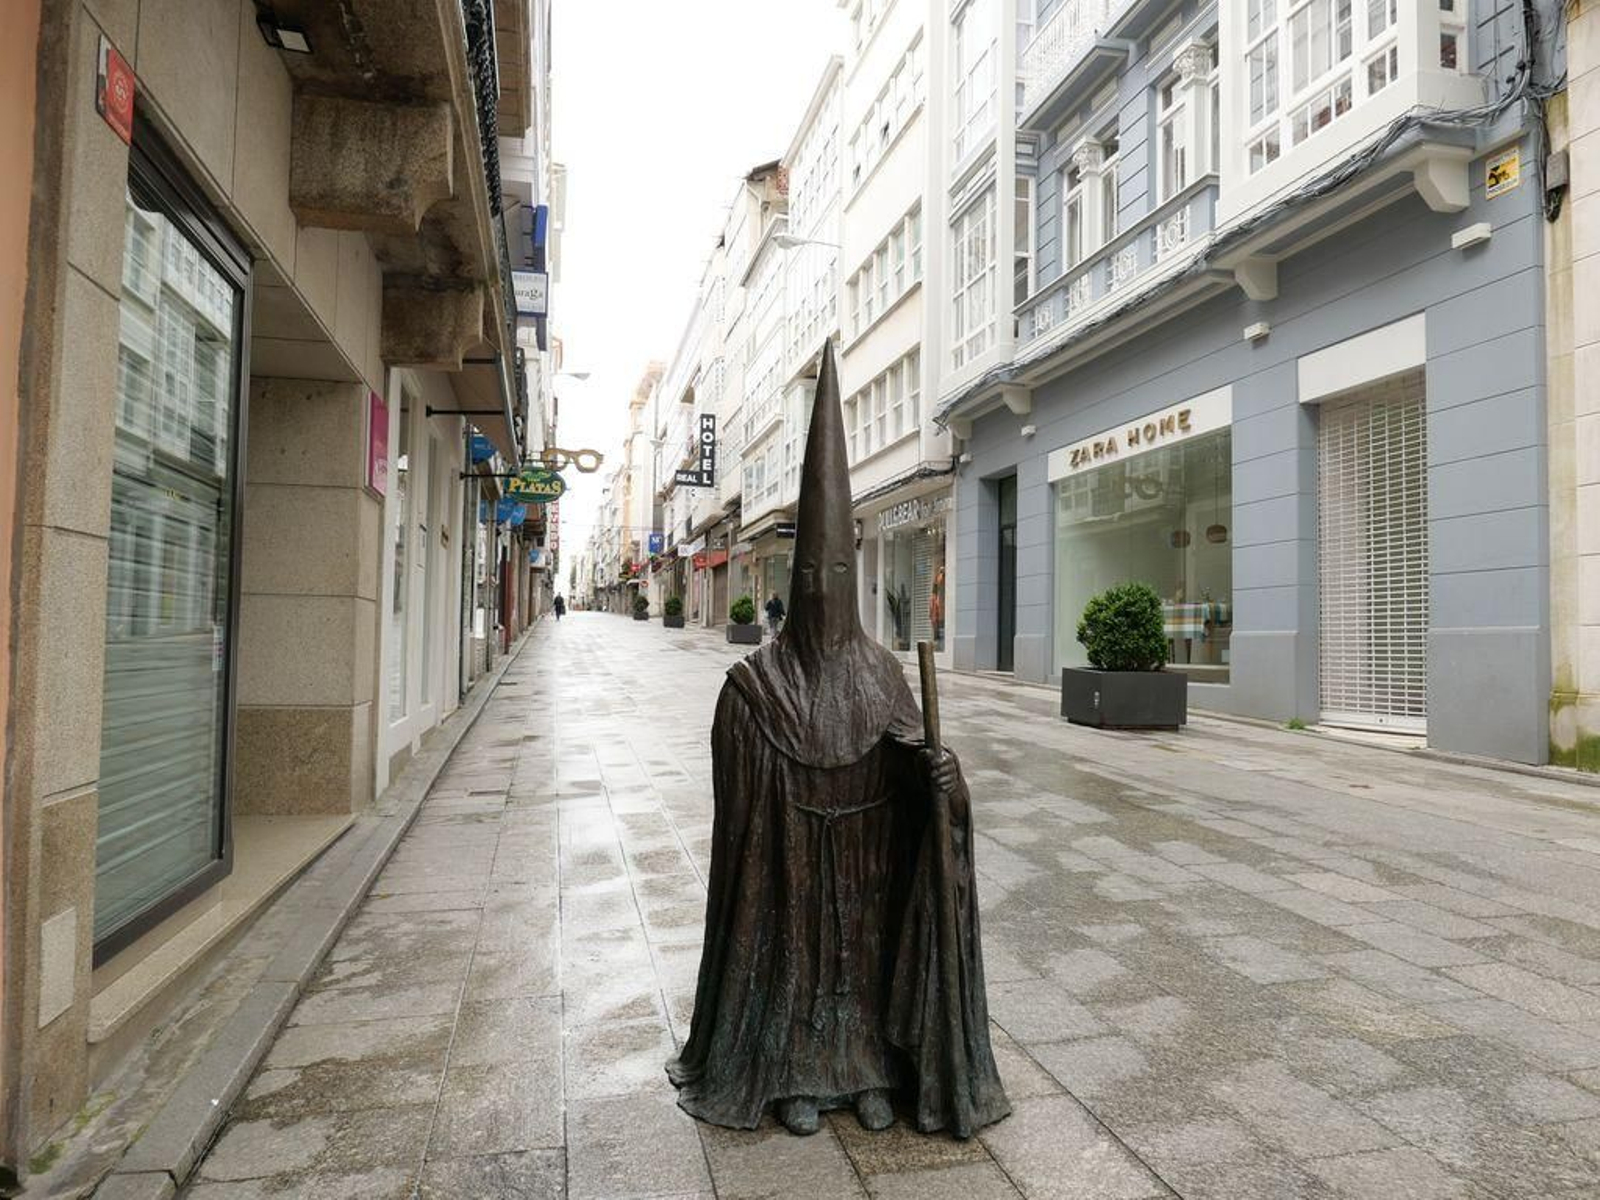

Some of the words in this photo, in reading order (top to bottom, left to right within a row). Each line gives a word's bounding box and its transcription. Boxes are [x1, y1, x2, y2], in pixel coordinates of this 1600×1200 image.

[702, 418, 714, 484] HOTEL
[1070, 437, 1118, 467] ZARA
[1127, 409, 1191, 446] HOME
[509, 477, 561, 494] PLATAS
[676, 473, 698, 483] REAL
